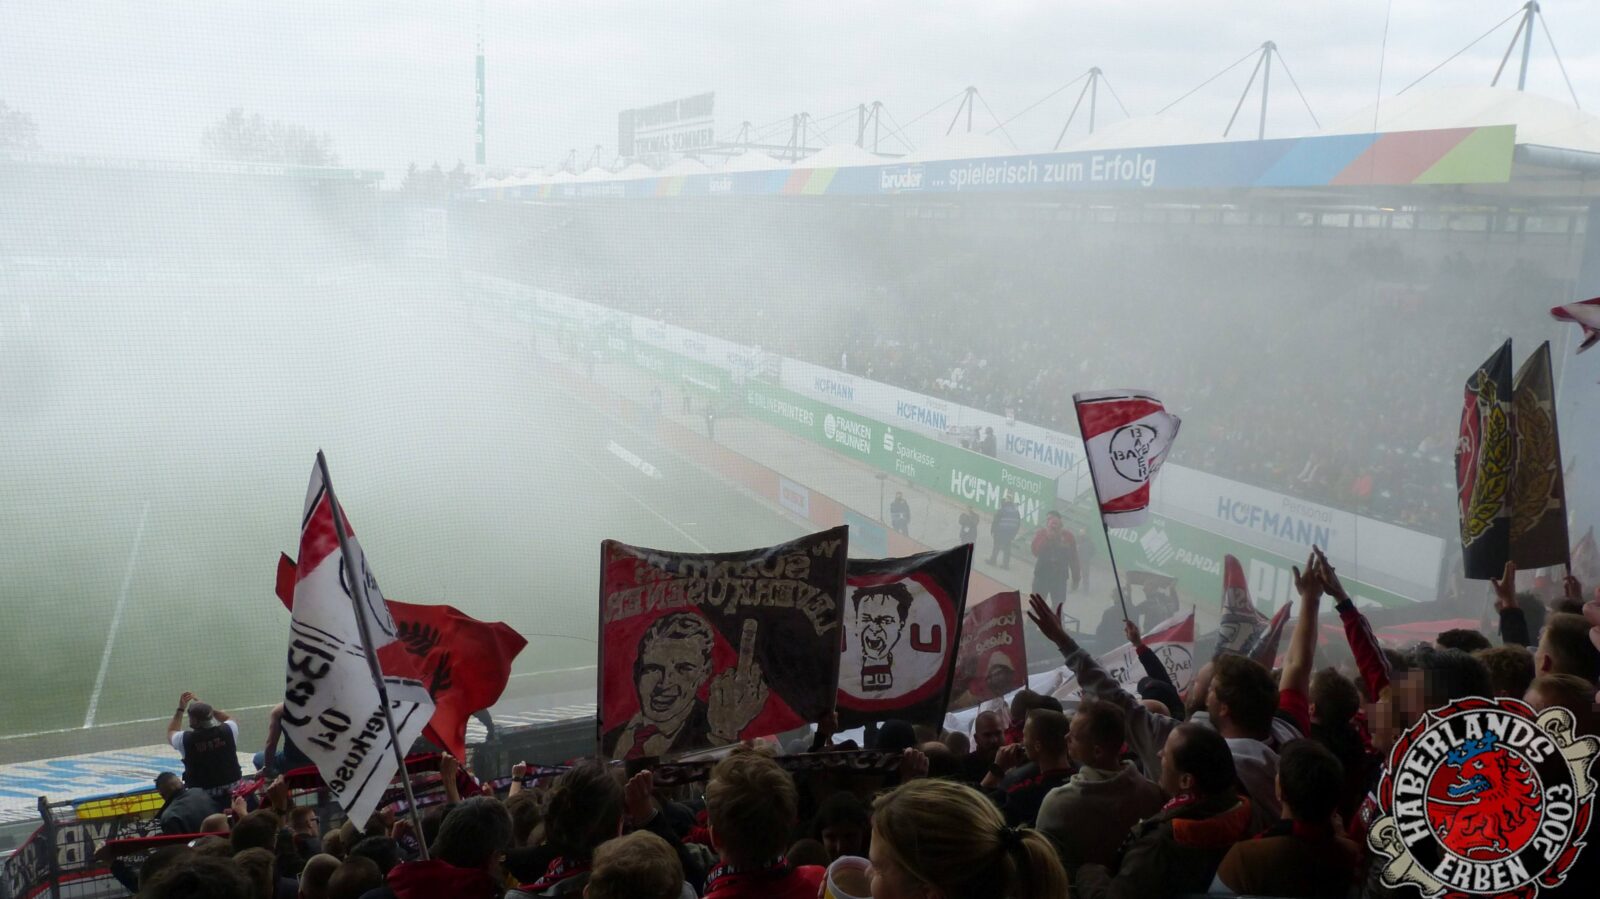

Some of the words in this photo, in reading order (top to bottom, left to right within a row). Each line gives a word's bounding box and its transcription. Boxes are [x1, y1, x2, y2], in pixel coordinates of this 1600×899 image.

[880, 168, 923, 189] bruder
[948, 158, 1038, 191] spielerisch
[1043, 160, 1084, 184] zum
[1091, 152, 1157, 188] Erfolg
[814, 376, 854, 401] HOFMANN
[836, 415, 872, 439] FRANKEN
[896, 400, 947, 431] HOFMANN
[835, 431, 871, 455] BRUNNEN
[896, 442, 935, 468] Sparkasse
[1005, 433, 1075, 470] HOFMANN
[895, 459, 916, 478] Fürth
[1001, 467, 1042, 493] Personal
[1217, 495, 1330, 551] HOFMANN
[1281, 497, 1333, 525] Personal
[1175, 547, 1220, 576] PANDA
